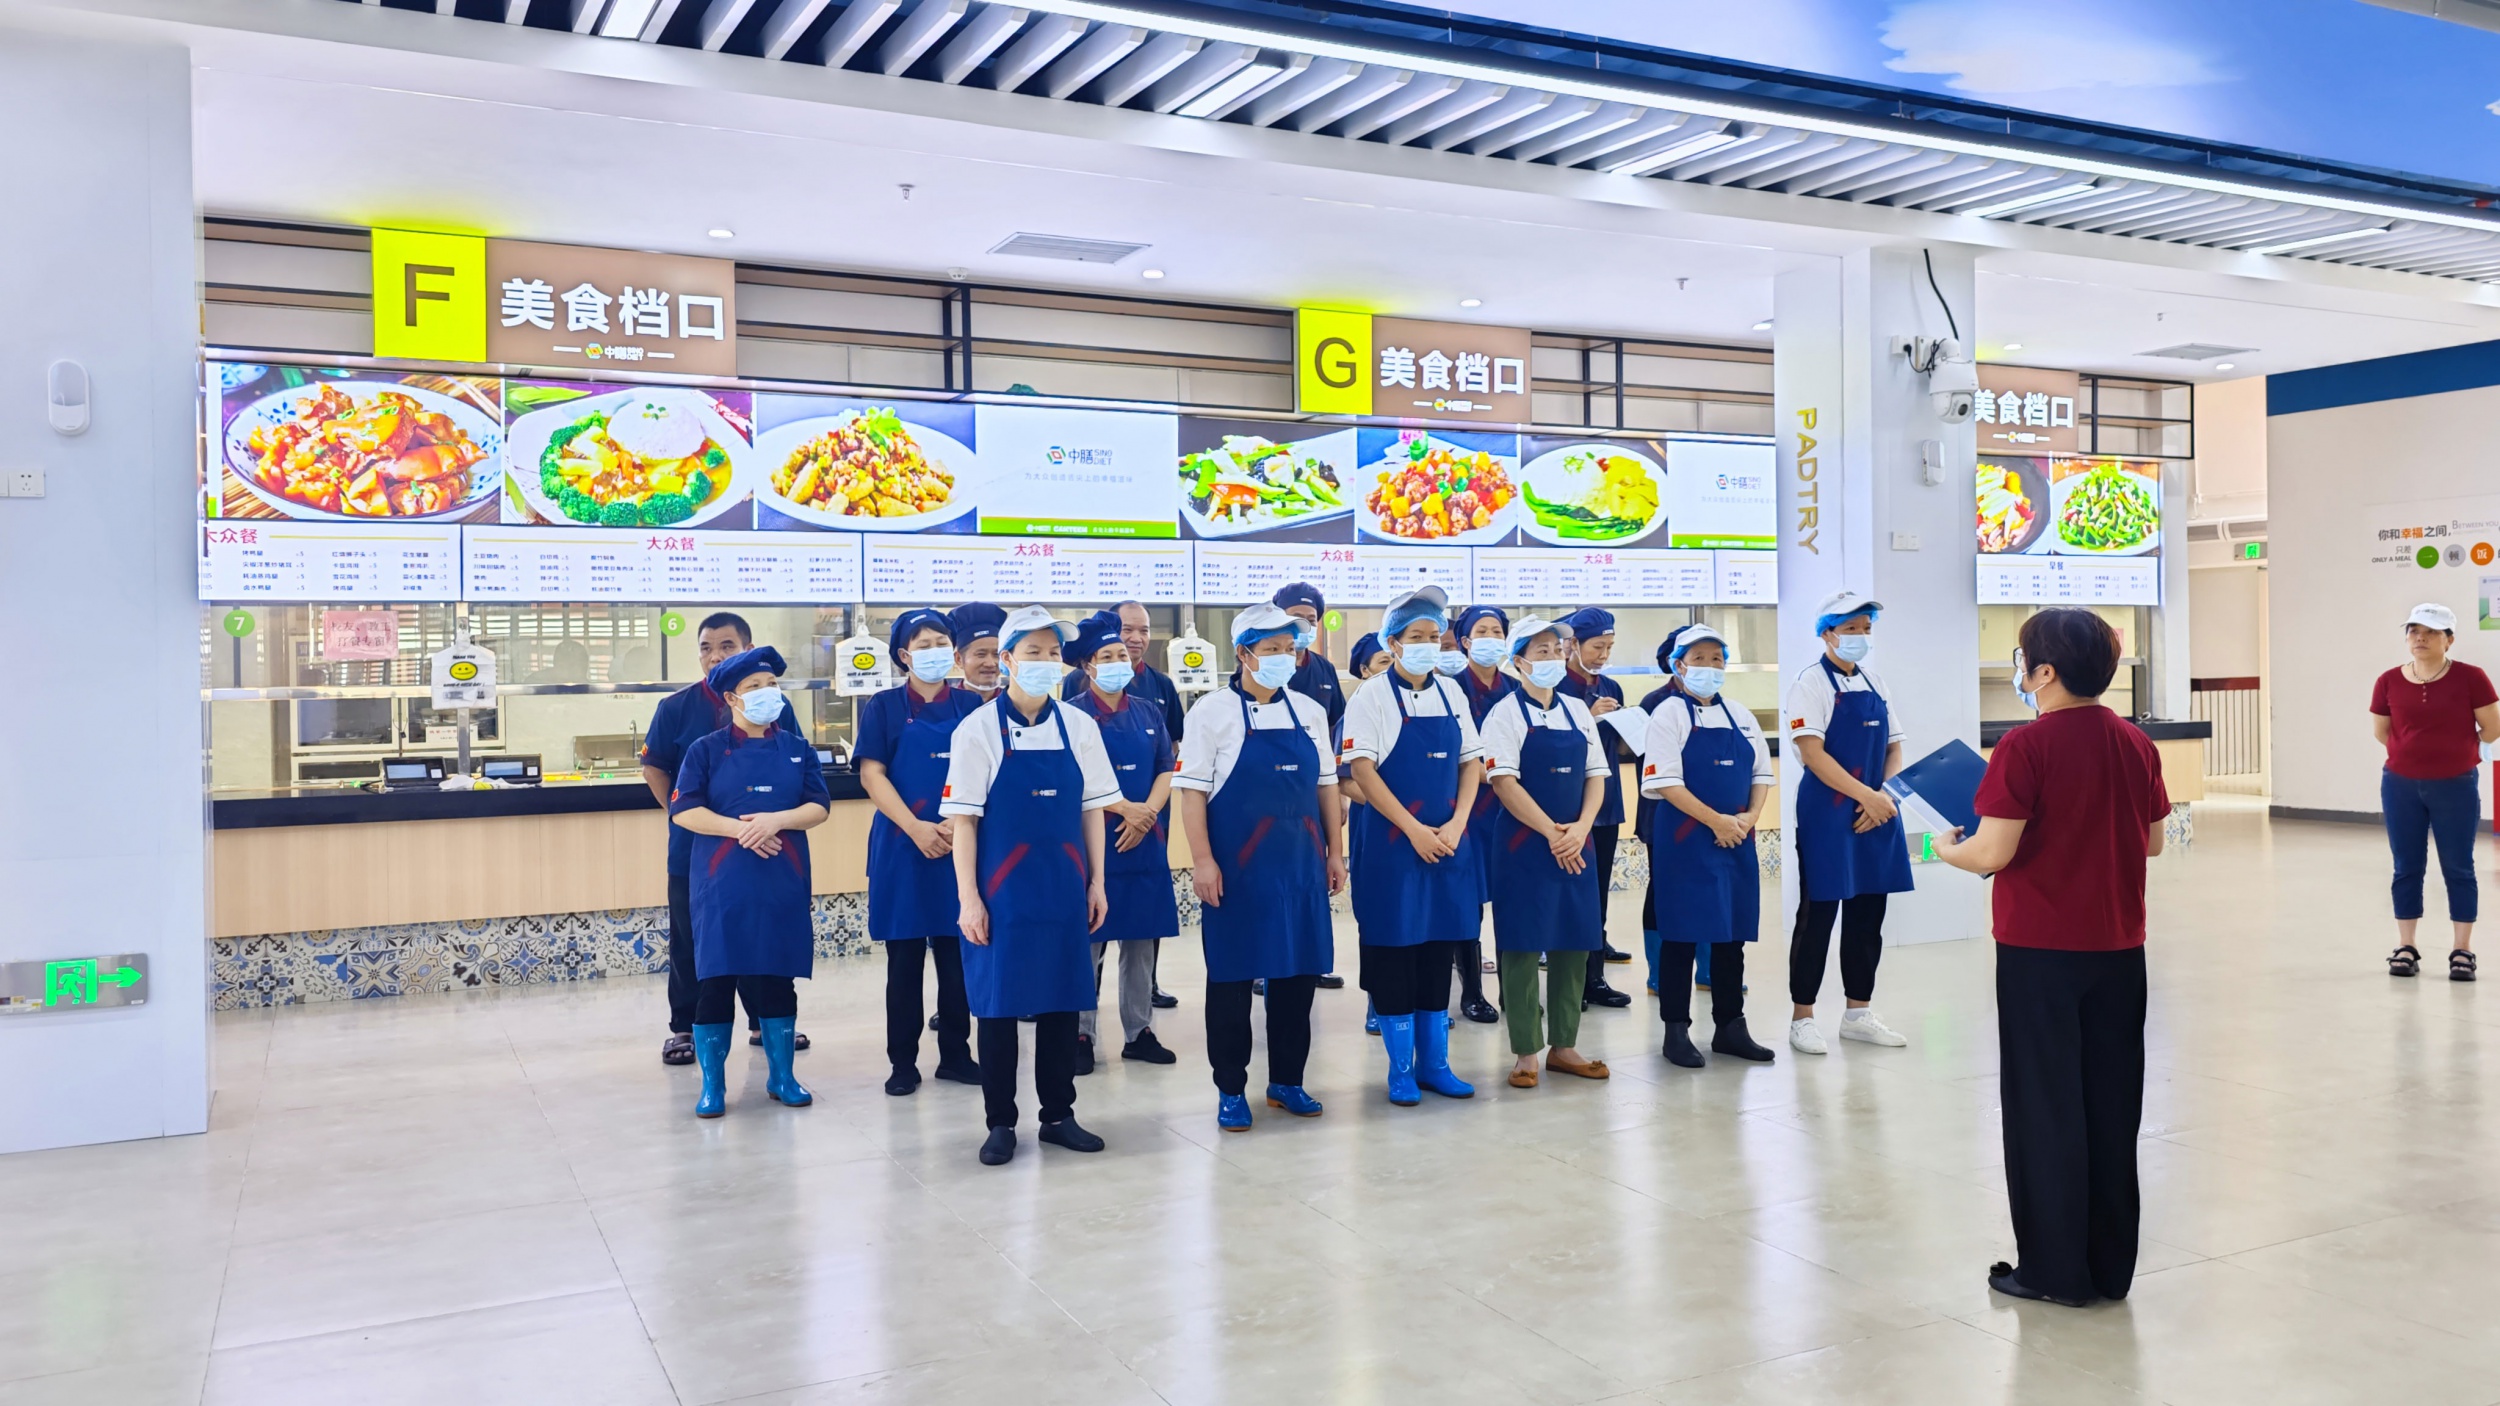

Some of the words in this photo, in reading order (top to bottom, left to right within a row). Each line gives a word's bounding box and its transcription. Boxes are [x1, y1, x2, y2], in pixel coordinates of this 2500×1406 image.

[405, 262, 455, 327] F
[501, 277, 724, 341] 美食档口
[1314, 337, 1357, 389] G
[1380, 346, 1525, 395] 美食档口
[1974, 388, 2074, 429] 美食档口
[1796, 407, 1819, 556] PADTRY
[646, 536, 695, 551] 大众餐
[1014, 543, 1055, 557] 大众餐
[1320, 550, 1355, 563] 大众餐
[1584, 553, 1614, 564] 大众餐
[2448, 550, 2460, 561] 顿
[2477, 548, 2487, 560] 饭
[234, 616, 246, 630] 7
[668, 618, 678, 630] 6
[1330, 616, 1337, 627] 4
